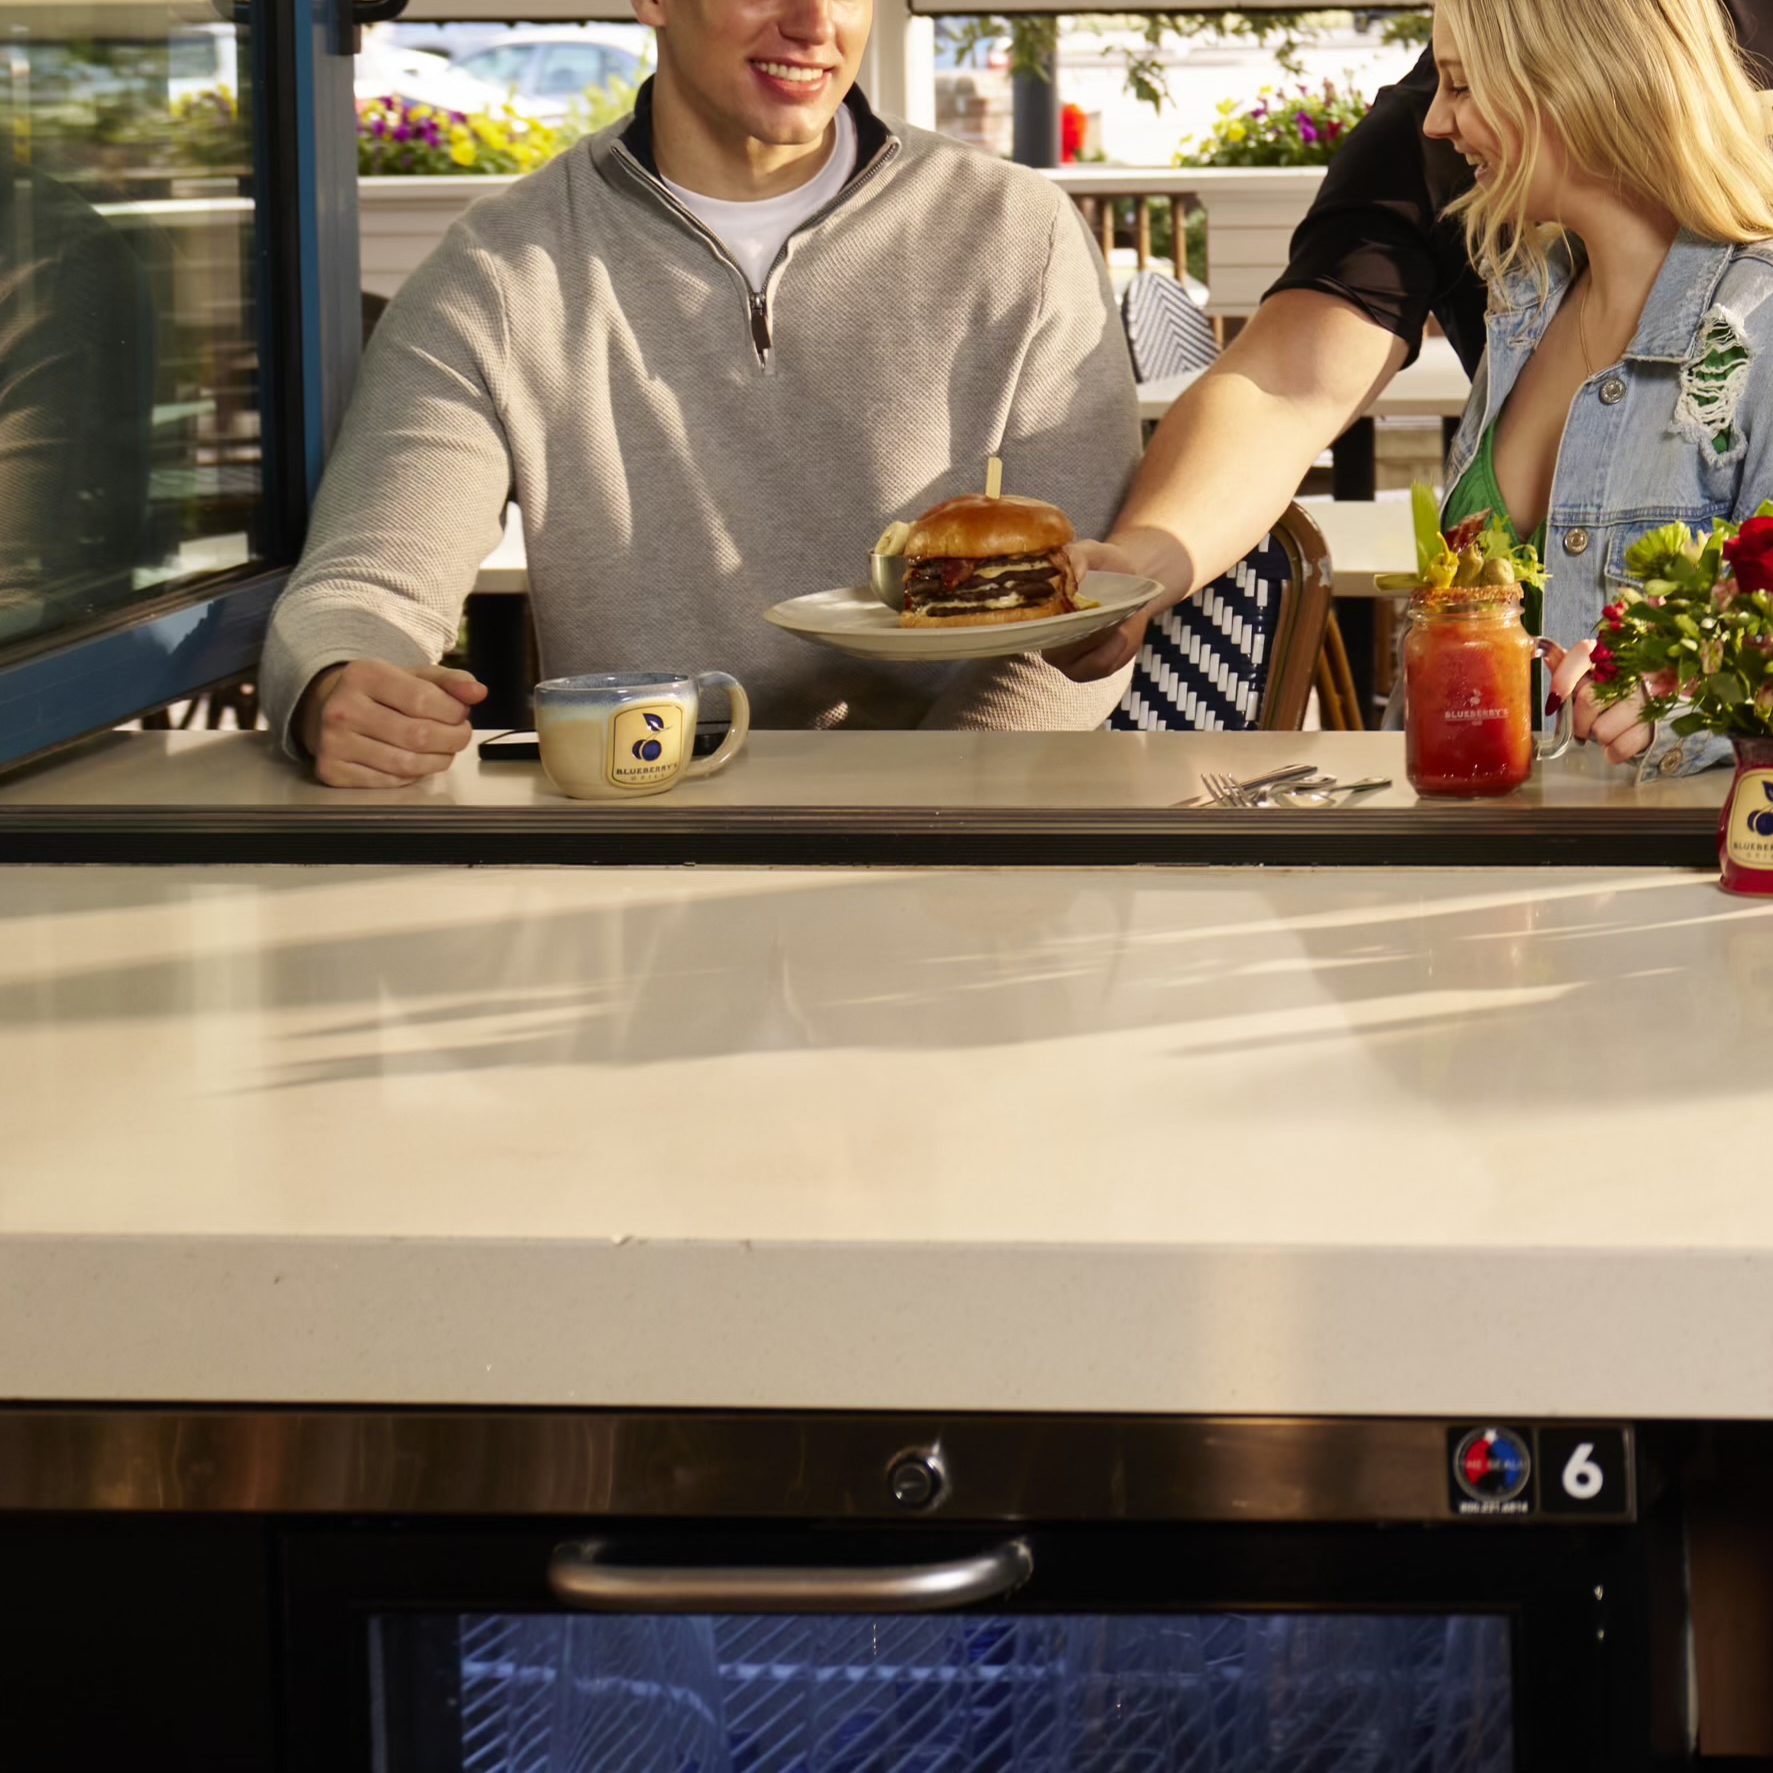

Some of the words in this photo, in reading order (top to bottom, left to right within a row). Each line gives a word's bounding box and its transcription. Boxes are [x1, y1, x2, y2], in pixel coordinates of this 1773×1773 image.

[1444, 708, 1510, 720] BLUEBERRY'S
[615, 762, 678, 775] BLUEBERRY'S
[1561, 1441, 1604, 1500] 6
